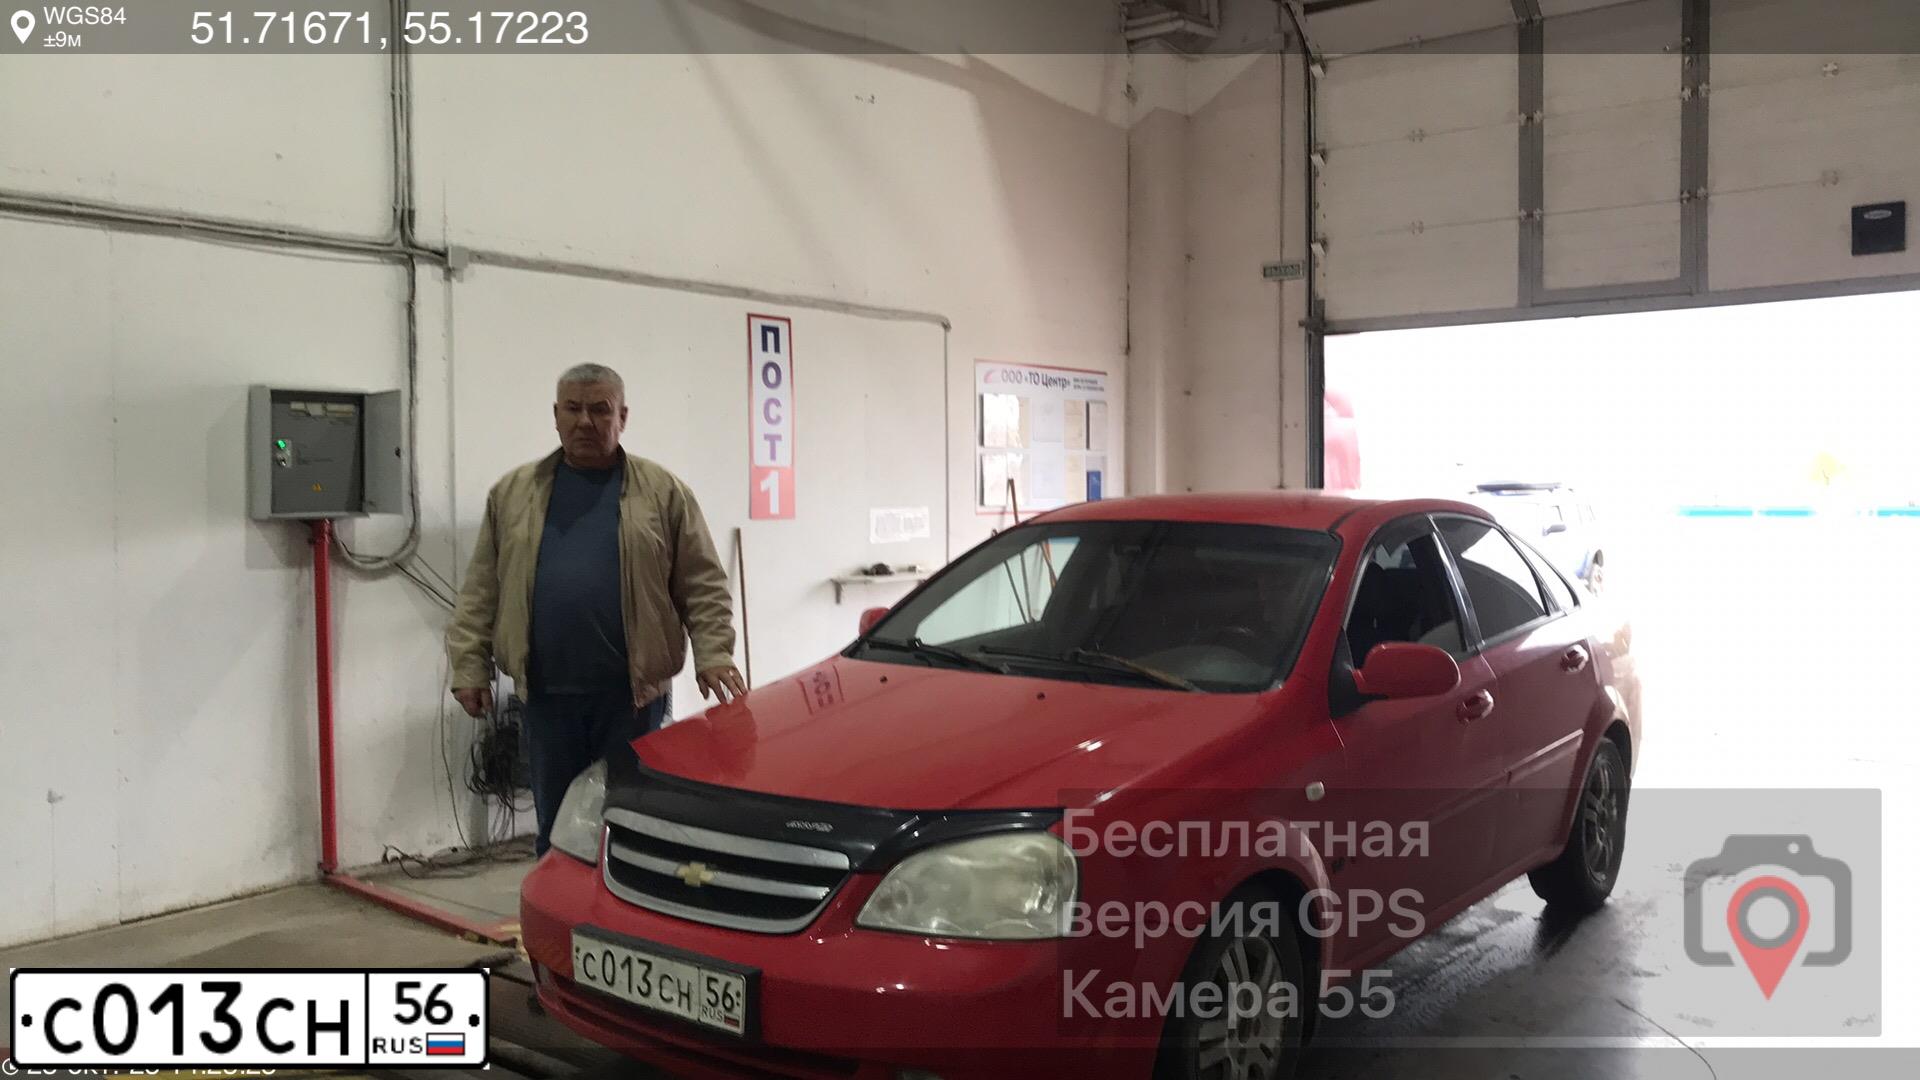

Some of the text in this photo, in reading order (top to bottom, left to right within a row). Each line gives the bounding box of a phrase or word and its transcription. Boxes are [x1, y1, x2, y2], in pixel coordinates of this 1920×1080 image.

[1001, 368, 1023, 385] ООО
[759, 324, 782, 516] ПОСТ 1
[582, 949, 735, 1013] С013СН 56
[701, 1005, 723, 1022] RUS
